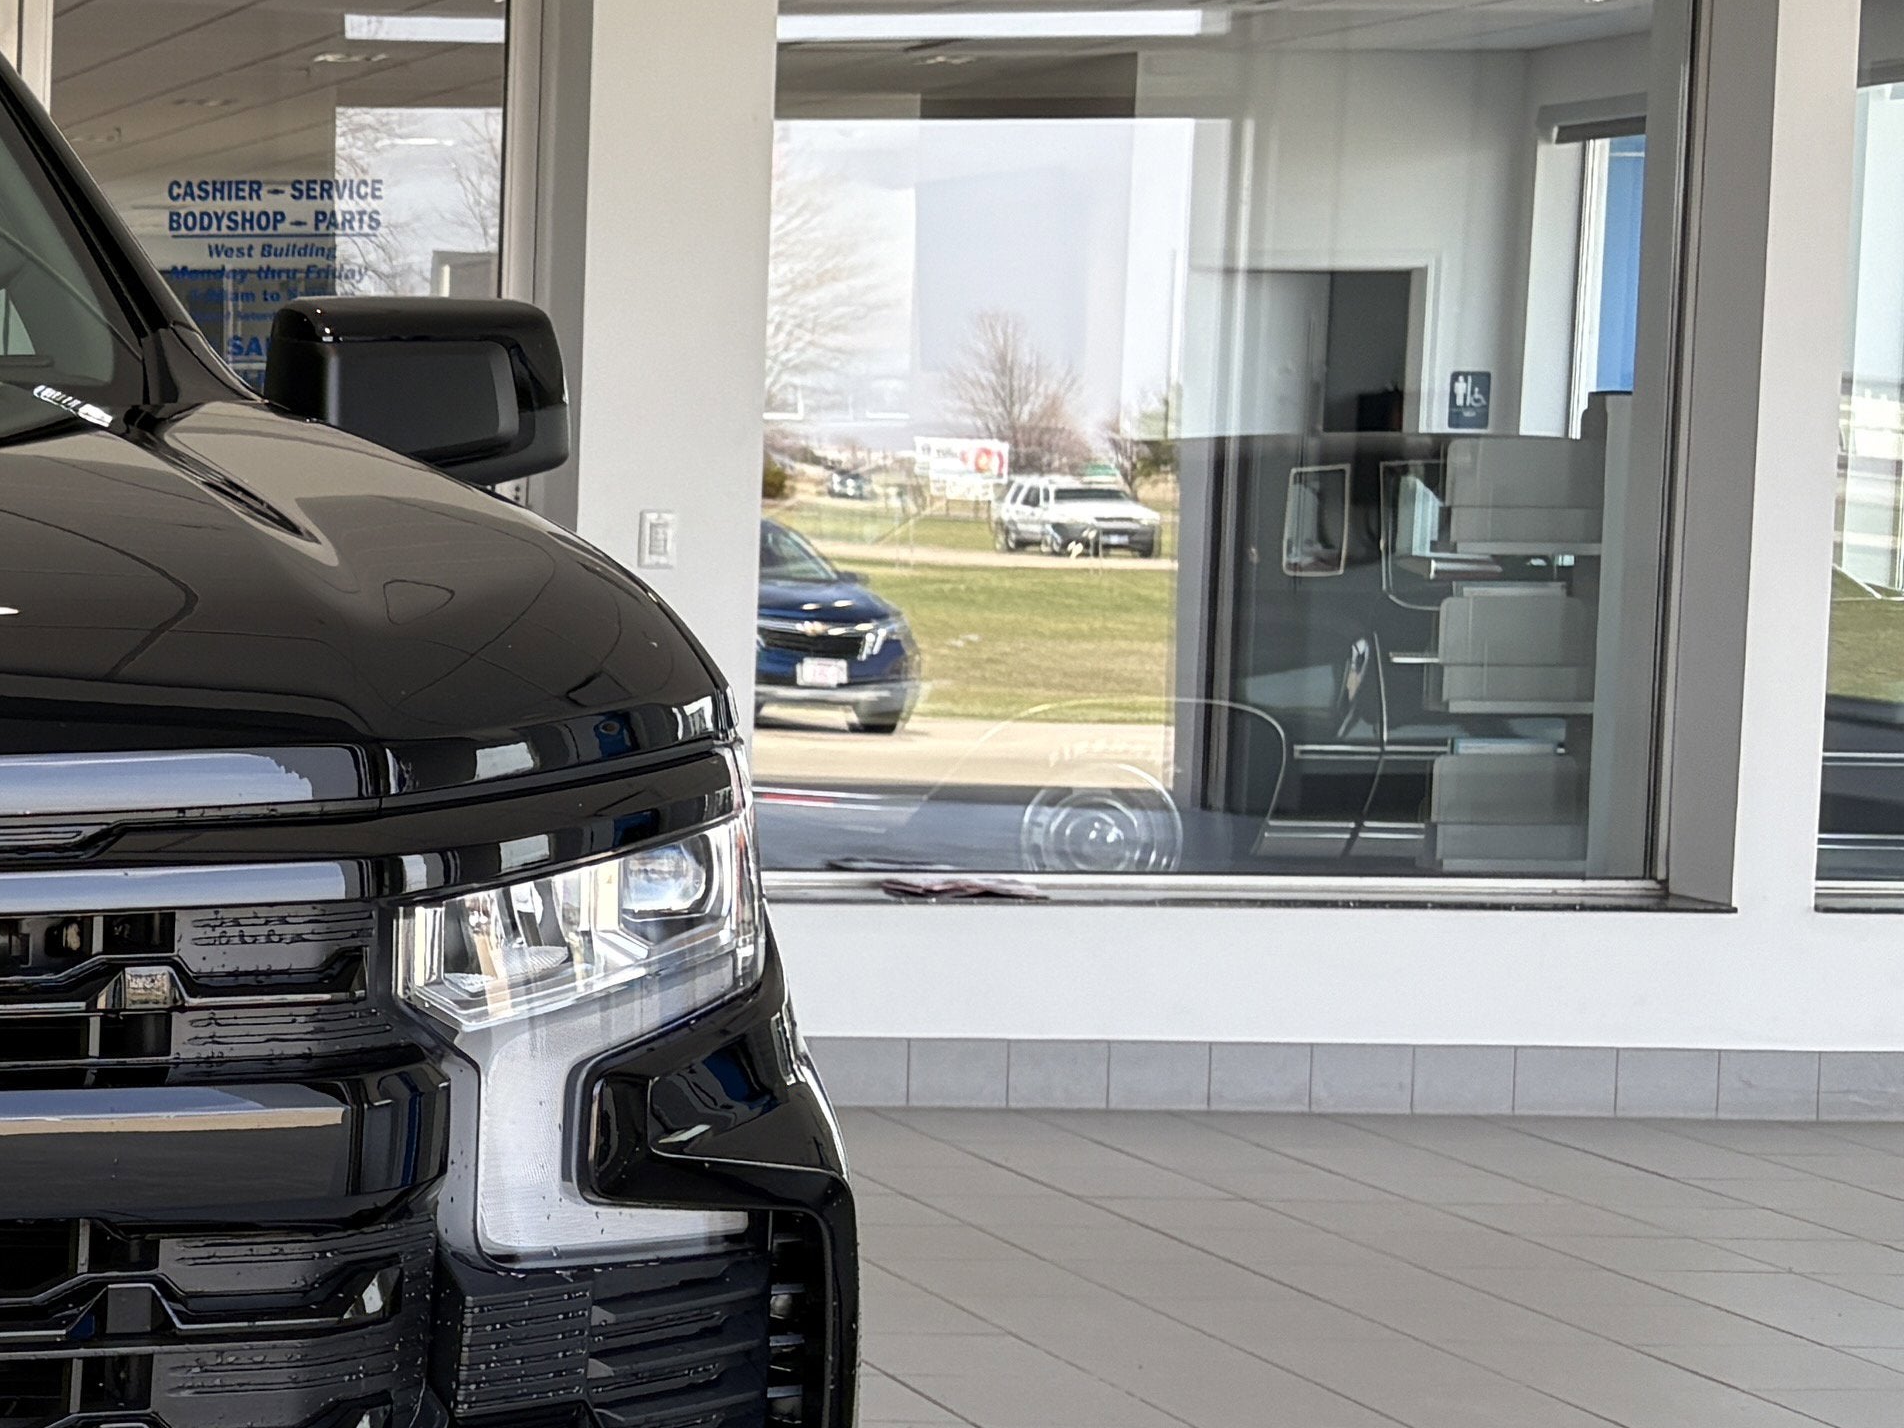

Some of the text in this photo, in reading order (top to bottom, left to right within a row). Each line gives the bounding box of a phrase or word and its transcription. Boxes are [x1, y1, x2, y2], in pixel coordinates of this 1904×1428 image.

[168, 180, 263, 201] CASHIER
[290, 179, 383, 200] SERVICE
[168, 210, 286, 231] BODYSHOP
[314, 210, 381, 231] PARTS
[208, 243, 337, 260] West Building
